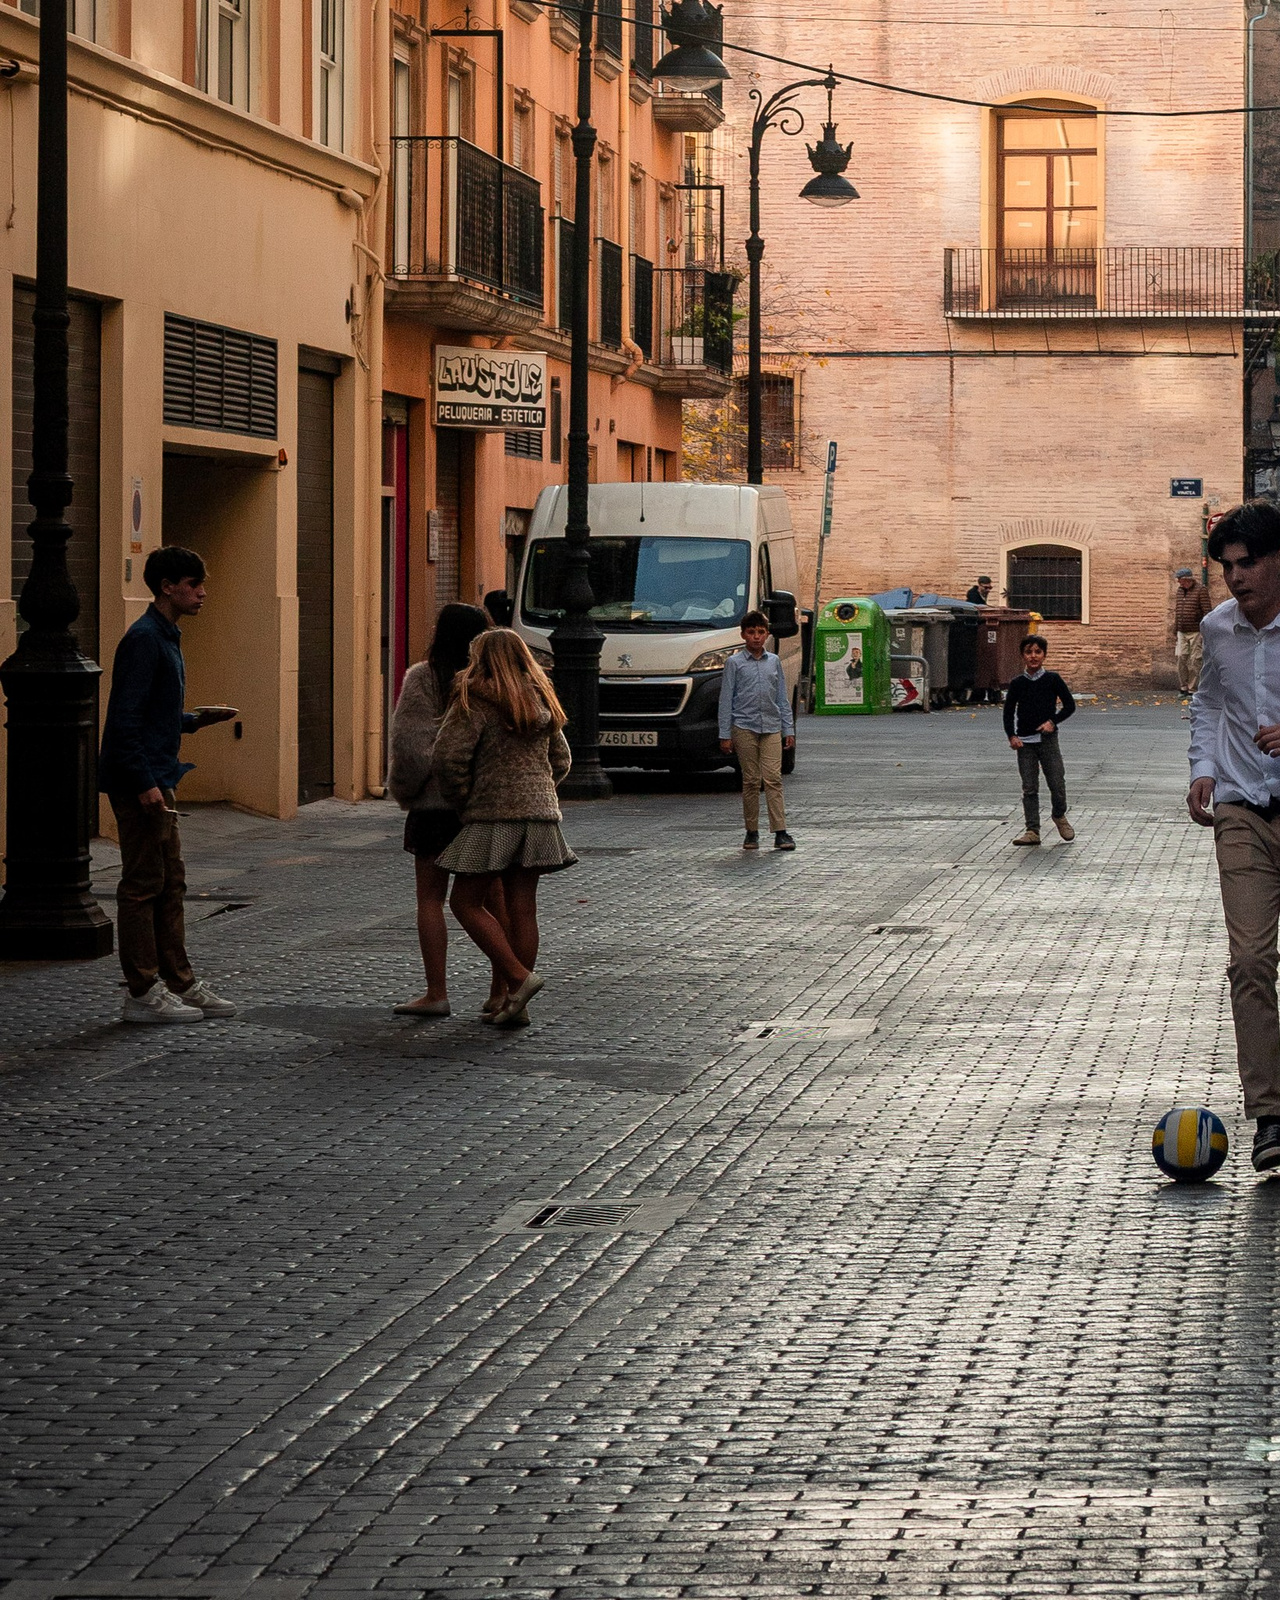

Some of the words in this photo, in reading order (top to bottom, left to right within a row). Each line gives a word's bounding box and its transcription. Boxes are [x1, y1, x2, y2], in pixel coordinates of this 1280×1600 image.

[439, 405, 493, 421] PELUQUERIA
[501, 409, 543, 424] ESTETICA
[599, 733, 628, 745] 7460
[631, 733, 654, 745] LKS
